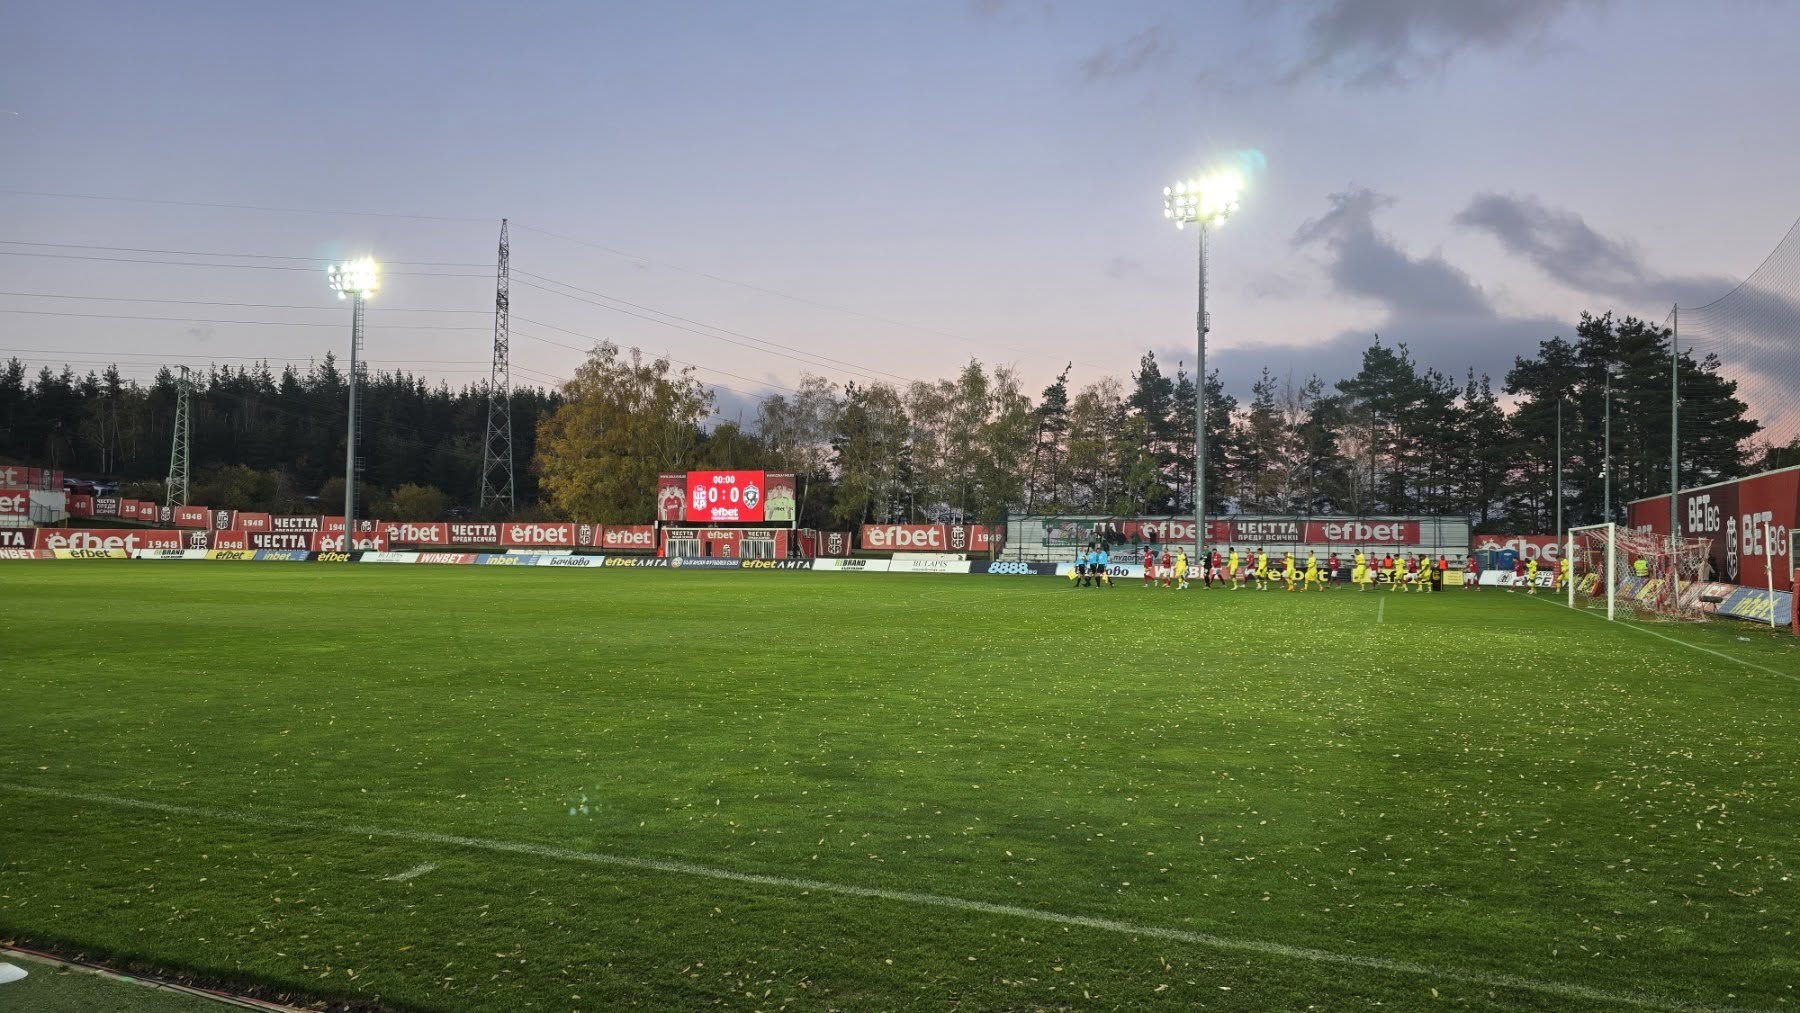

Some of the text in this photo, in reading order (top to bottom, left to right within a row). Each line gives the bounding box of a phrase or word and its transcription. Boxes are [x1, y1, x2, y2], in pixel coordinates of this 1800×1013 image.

[708, 487, 718, 503] 0
[730, 487, 740, 503] 0
[274, 518, 319, 528] ЧЕСТТА
[1237, 522, 1298, 535] ЧЕСТТА
[386, 524, 440, 542] efbet
[452, 525, 497, 536] ЧЕСТТА
[511, 525, 568, 543] efbet
[708, 530, 734, 539] efbet
[1323, 522, 1404, 541] efbet
[253, 534, 306, 548] ЧЕСТТА
[606, 530, 652, 544] efbet
[868, 526, 940, 547] efbet
[977, 533, 1002, 542] 1948
[46, 532, 140, 553] efbet
[147, 541, 178, 549] 1948
[218, 541, 243, 549] 1948
[71, 549, 110, 558] efbet
[215, 551, 245, 560] efbet
[317, 551, 351, 562] efbet
[420, 553, 466, 563] WINBET
[549, 557, 591, 566] Бачково
